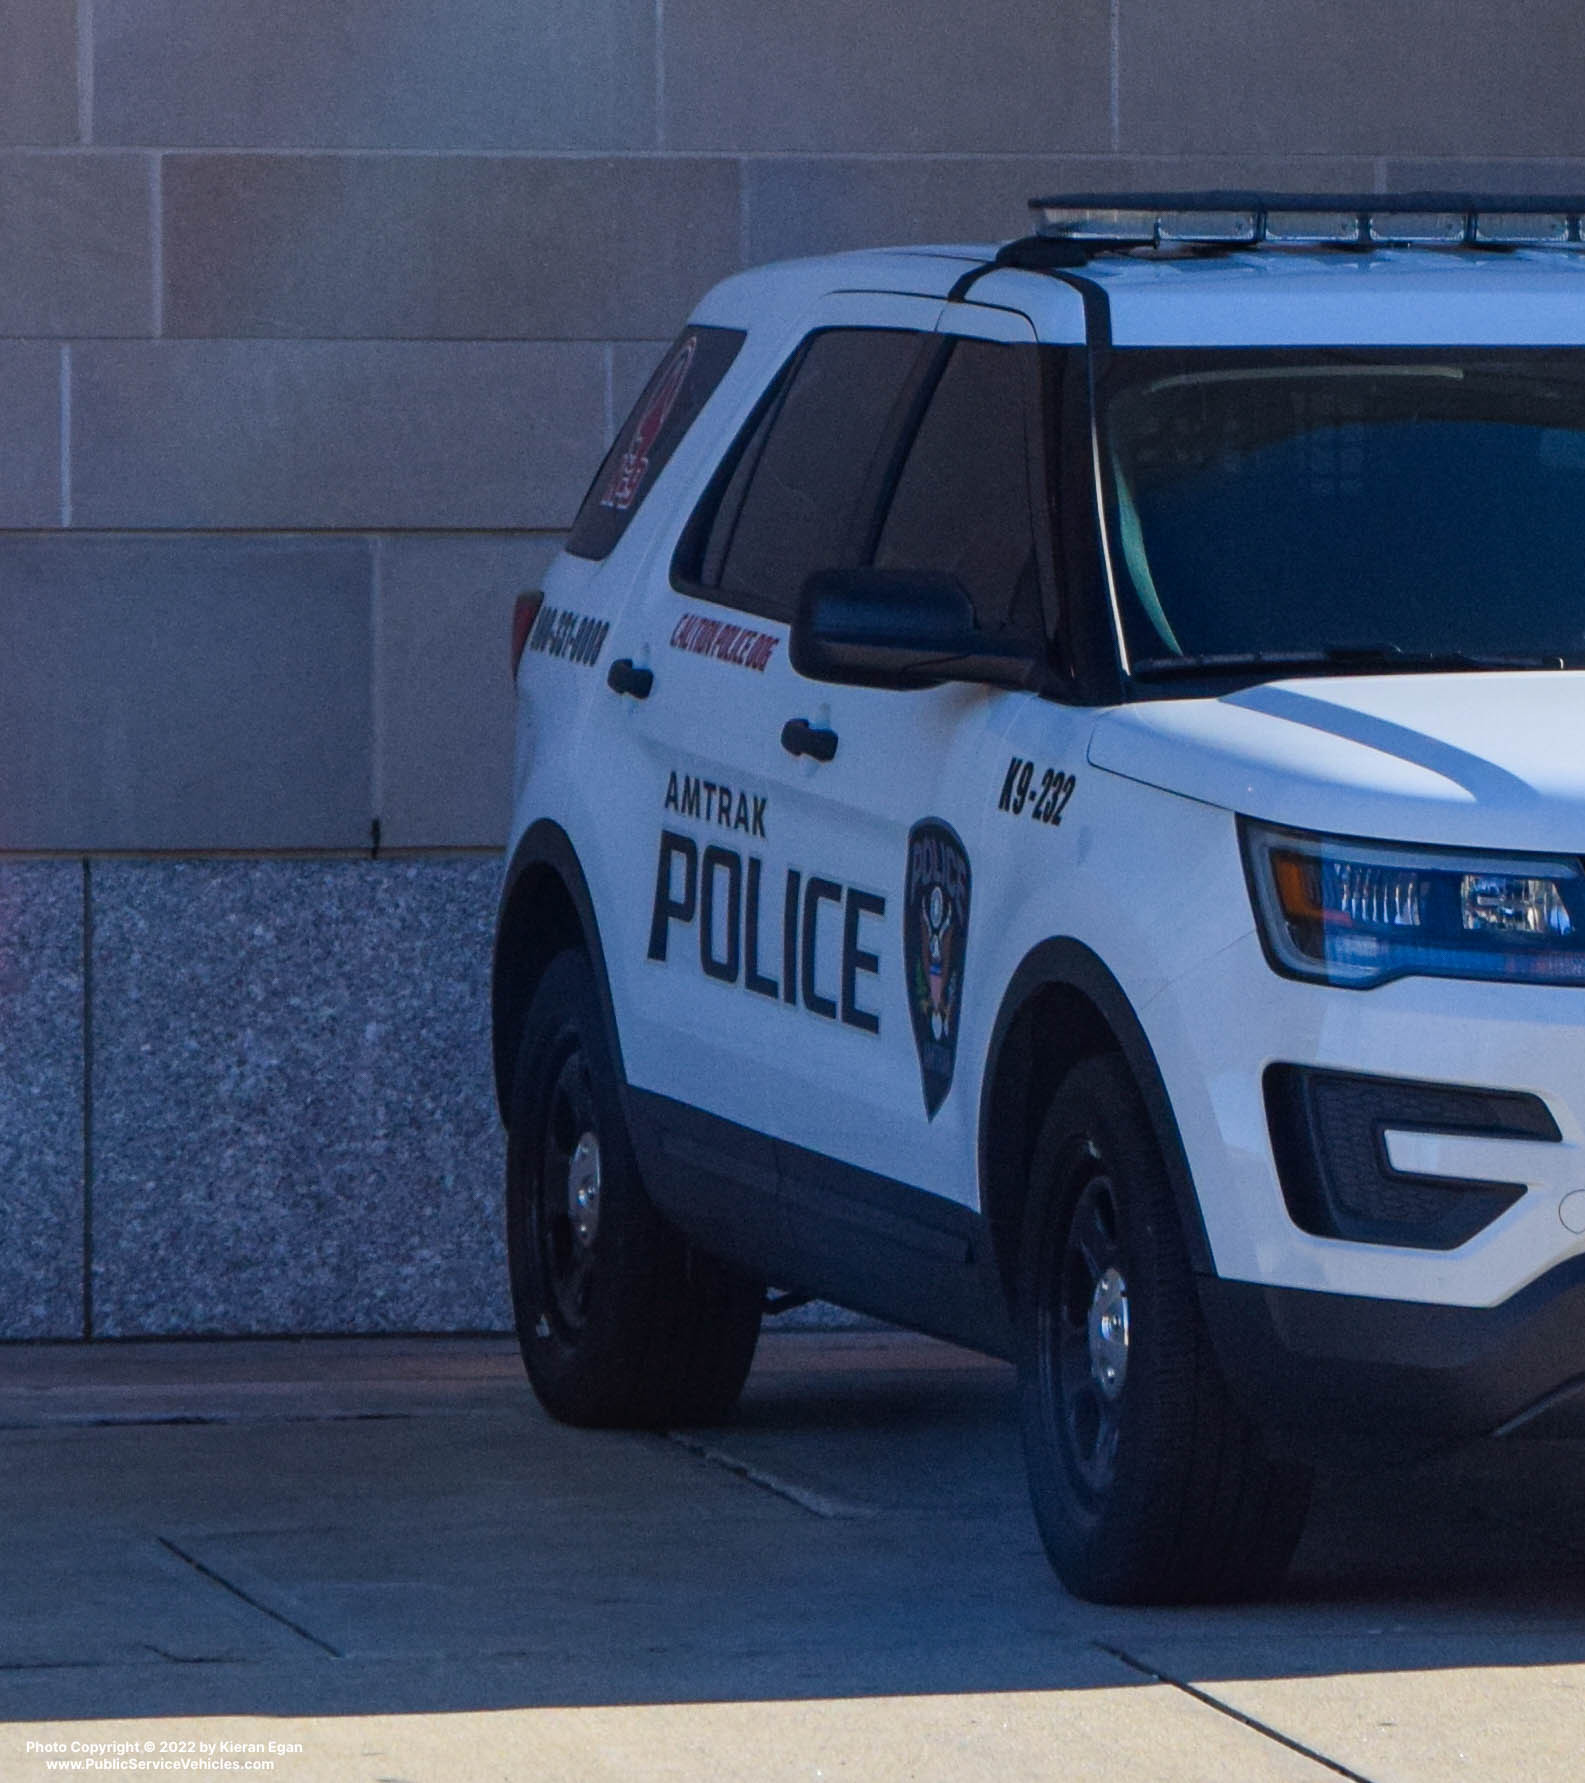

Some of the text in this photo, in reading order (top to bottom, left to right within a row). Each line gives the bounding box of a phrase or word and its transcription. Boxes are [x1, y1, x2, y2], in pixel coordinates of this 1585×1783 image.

[670, 612, 722, 656] CAUTION
[711, 624, 758, 665] POLICE
[665, 770, 768, 839] AMTRAK
[998, 757, 1076, 827] K9-232
[647, 830, 886, 1035] POLICE
